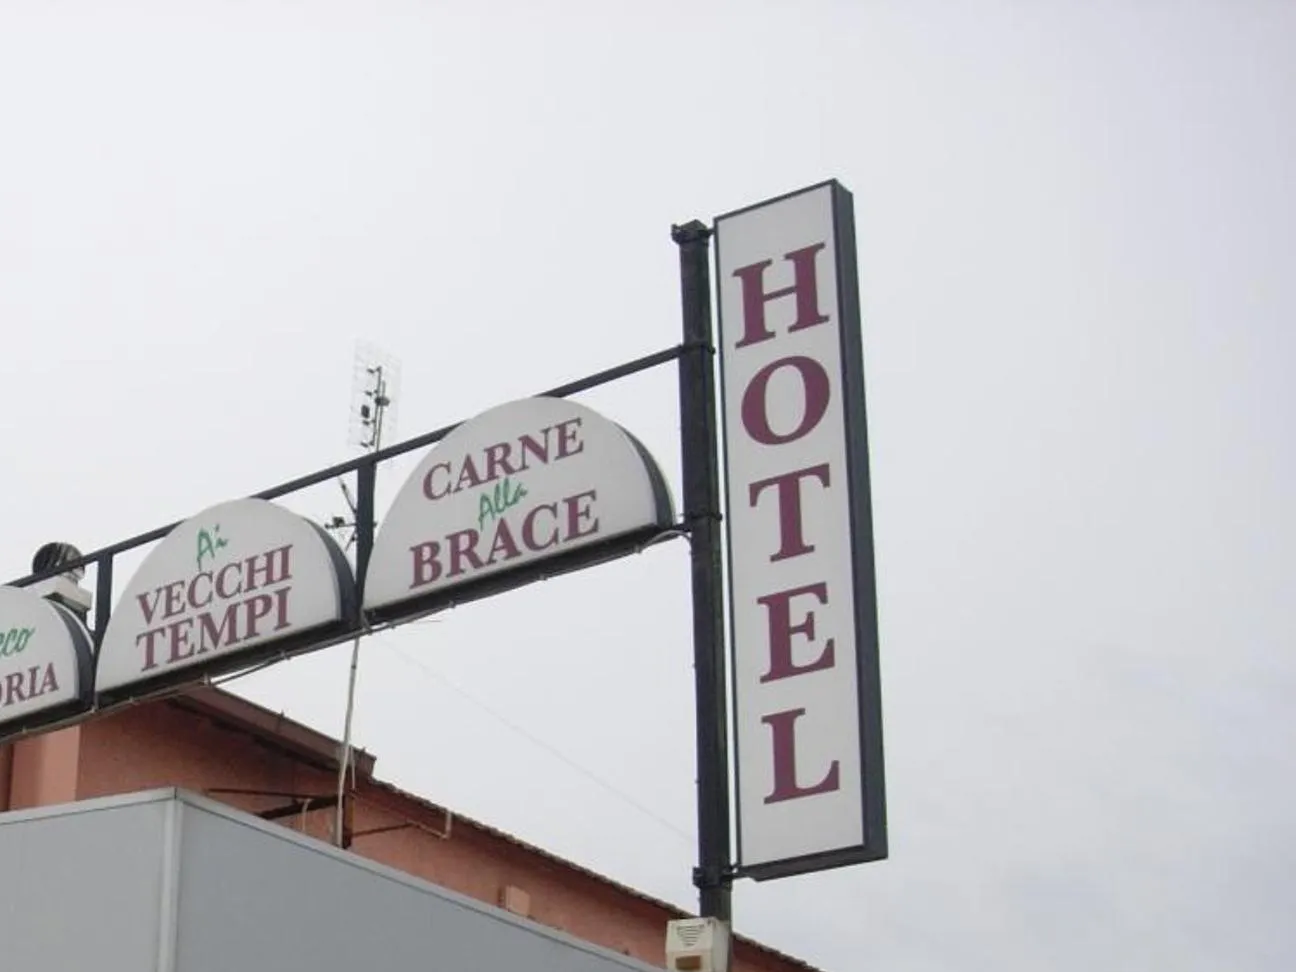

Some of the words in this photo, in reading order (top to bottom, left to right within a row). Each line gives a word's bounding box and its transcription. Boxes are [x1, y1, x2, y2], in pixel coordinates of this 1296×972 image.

[422, 417, 584, 501] CARNE
[196, 523, 228, 569] Ai
[409, 489, 599, 590] BRACE
[478, 477, 528, 531] Alla
[732, 241, 841, 804] HOTEL
[136, 544, 293, 625] VECCHI
[136, 587, 292, 671] TEMPI
